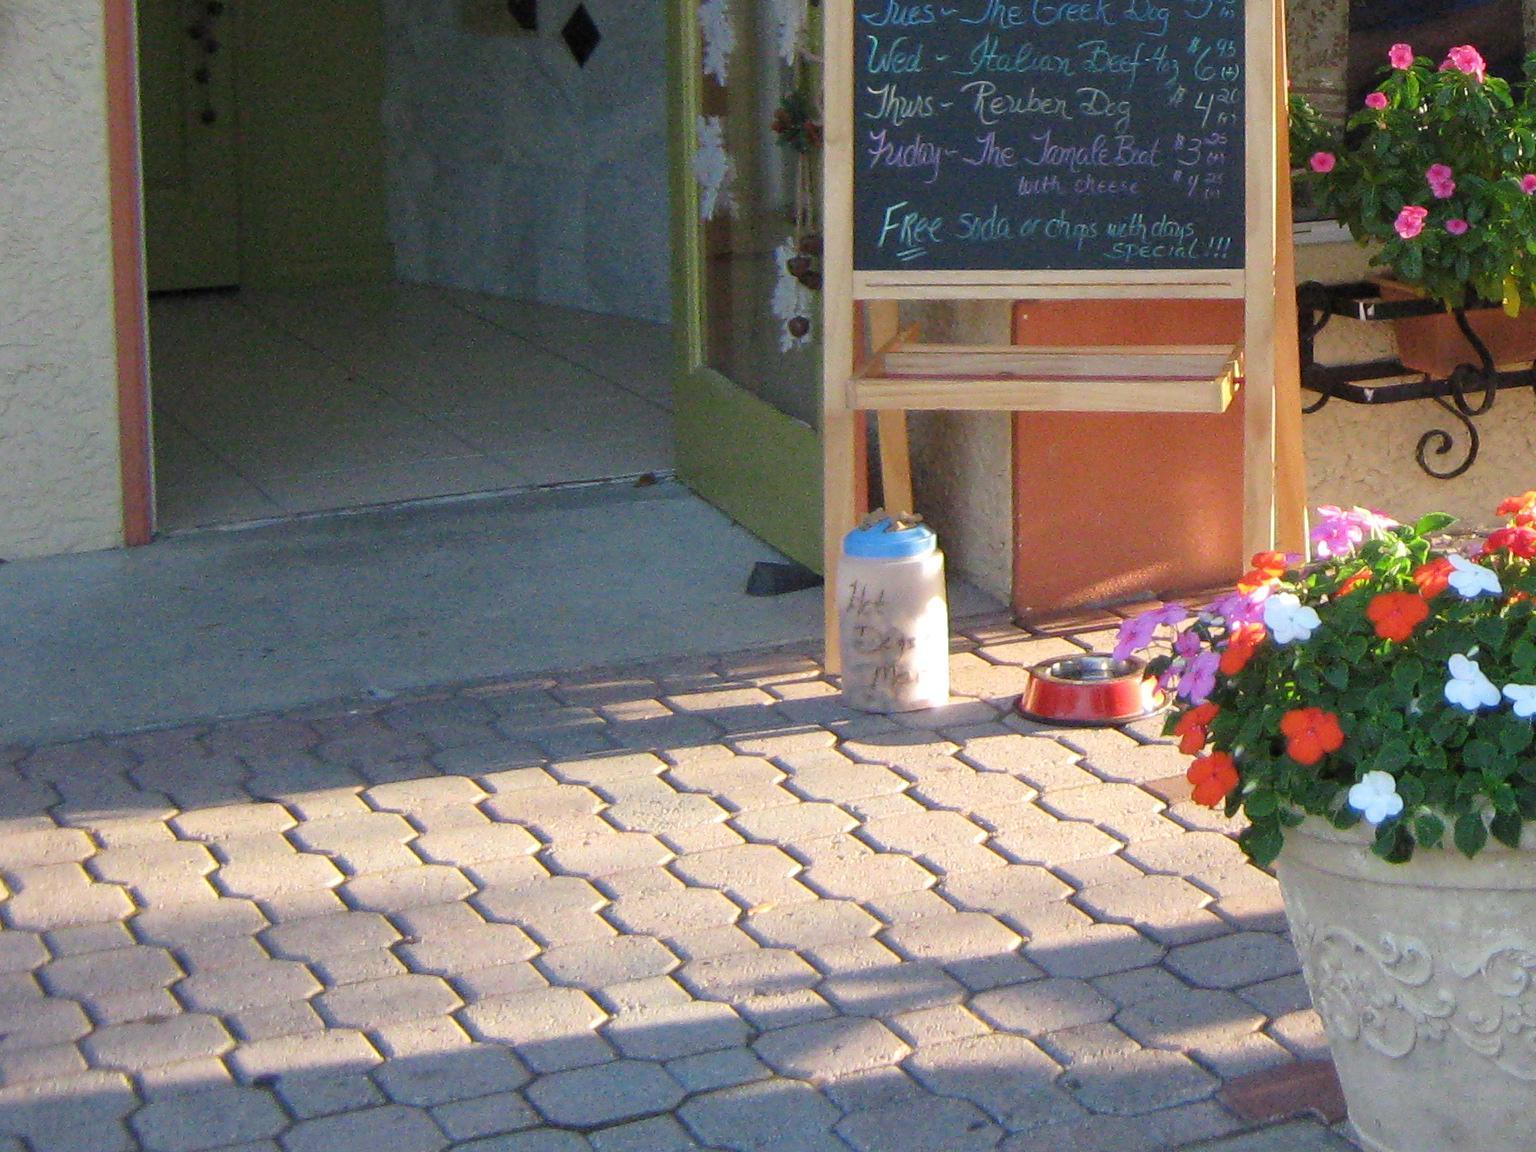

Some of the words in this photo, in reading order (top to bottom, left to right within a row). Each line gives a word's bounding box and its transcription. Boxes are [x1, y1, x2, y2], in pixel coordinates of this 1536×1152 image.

[866, 34, 924, 73] Wed
[952, 33, 1074, 77] Italian
[961, 81, 1073, 124] Reuben
[1076, 87, 1132, 133] Dog
[963, 131, 1018, 166] The
